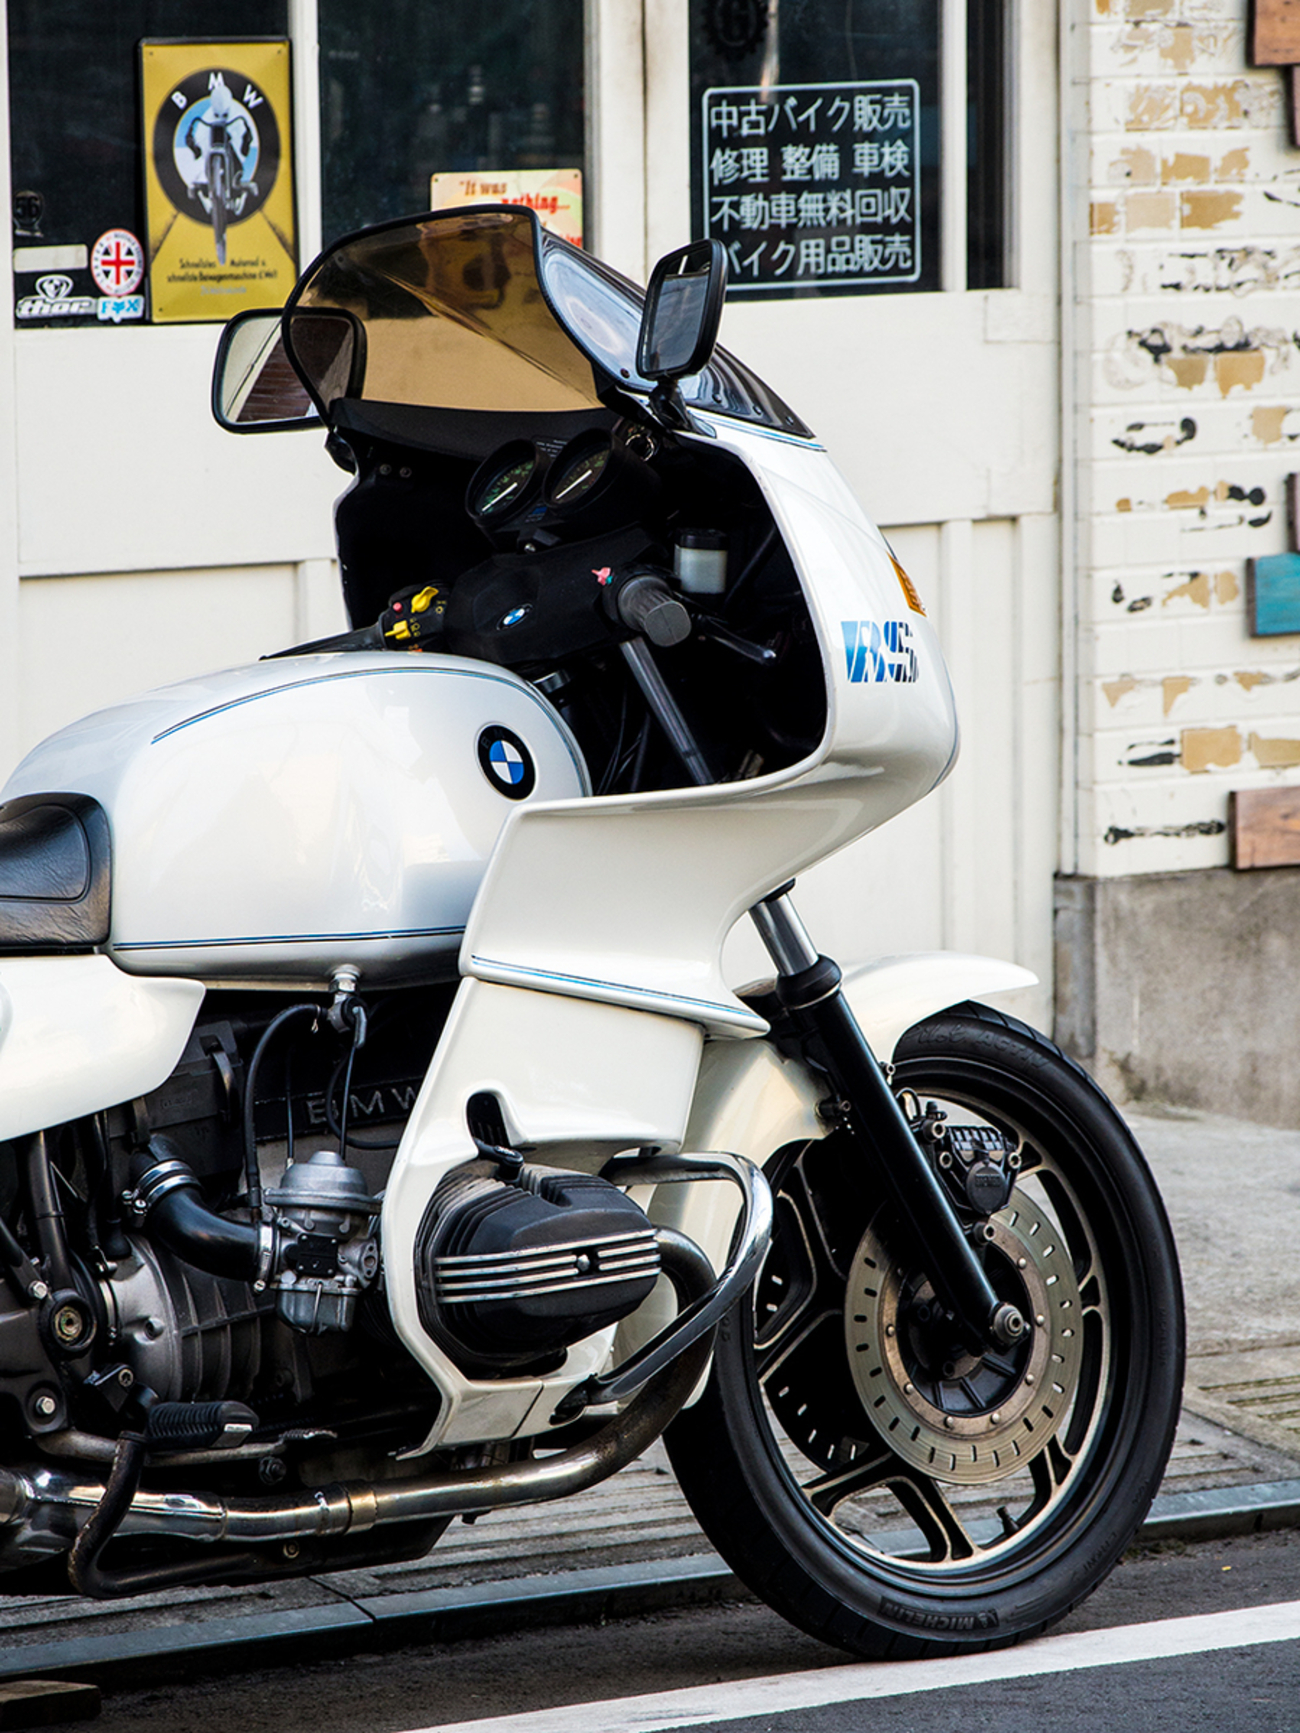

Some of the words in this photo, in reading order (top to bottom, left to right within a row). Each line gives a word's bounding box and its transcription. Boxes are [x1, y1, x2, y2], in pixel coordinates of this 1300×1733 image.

[171, 72, 264, 110] BMW
[710, 93, 912, 138] 中古バイク販売
[710, 146, 770, 186] 修理
[781, 142, 840, 182] 整備
[852, 138, 911, 179] 車検
[480, 182, 507, 195] was
[710, 186, 912, 233] 不動車無料回収
[840, 621, 920, 683] RS
[306, 1086, 416, 1124] BMW
[881, 1602, 975, 1630] MICHELIN
